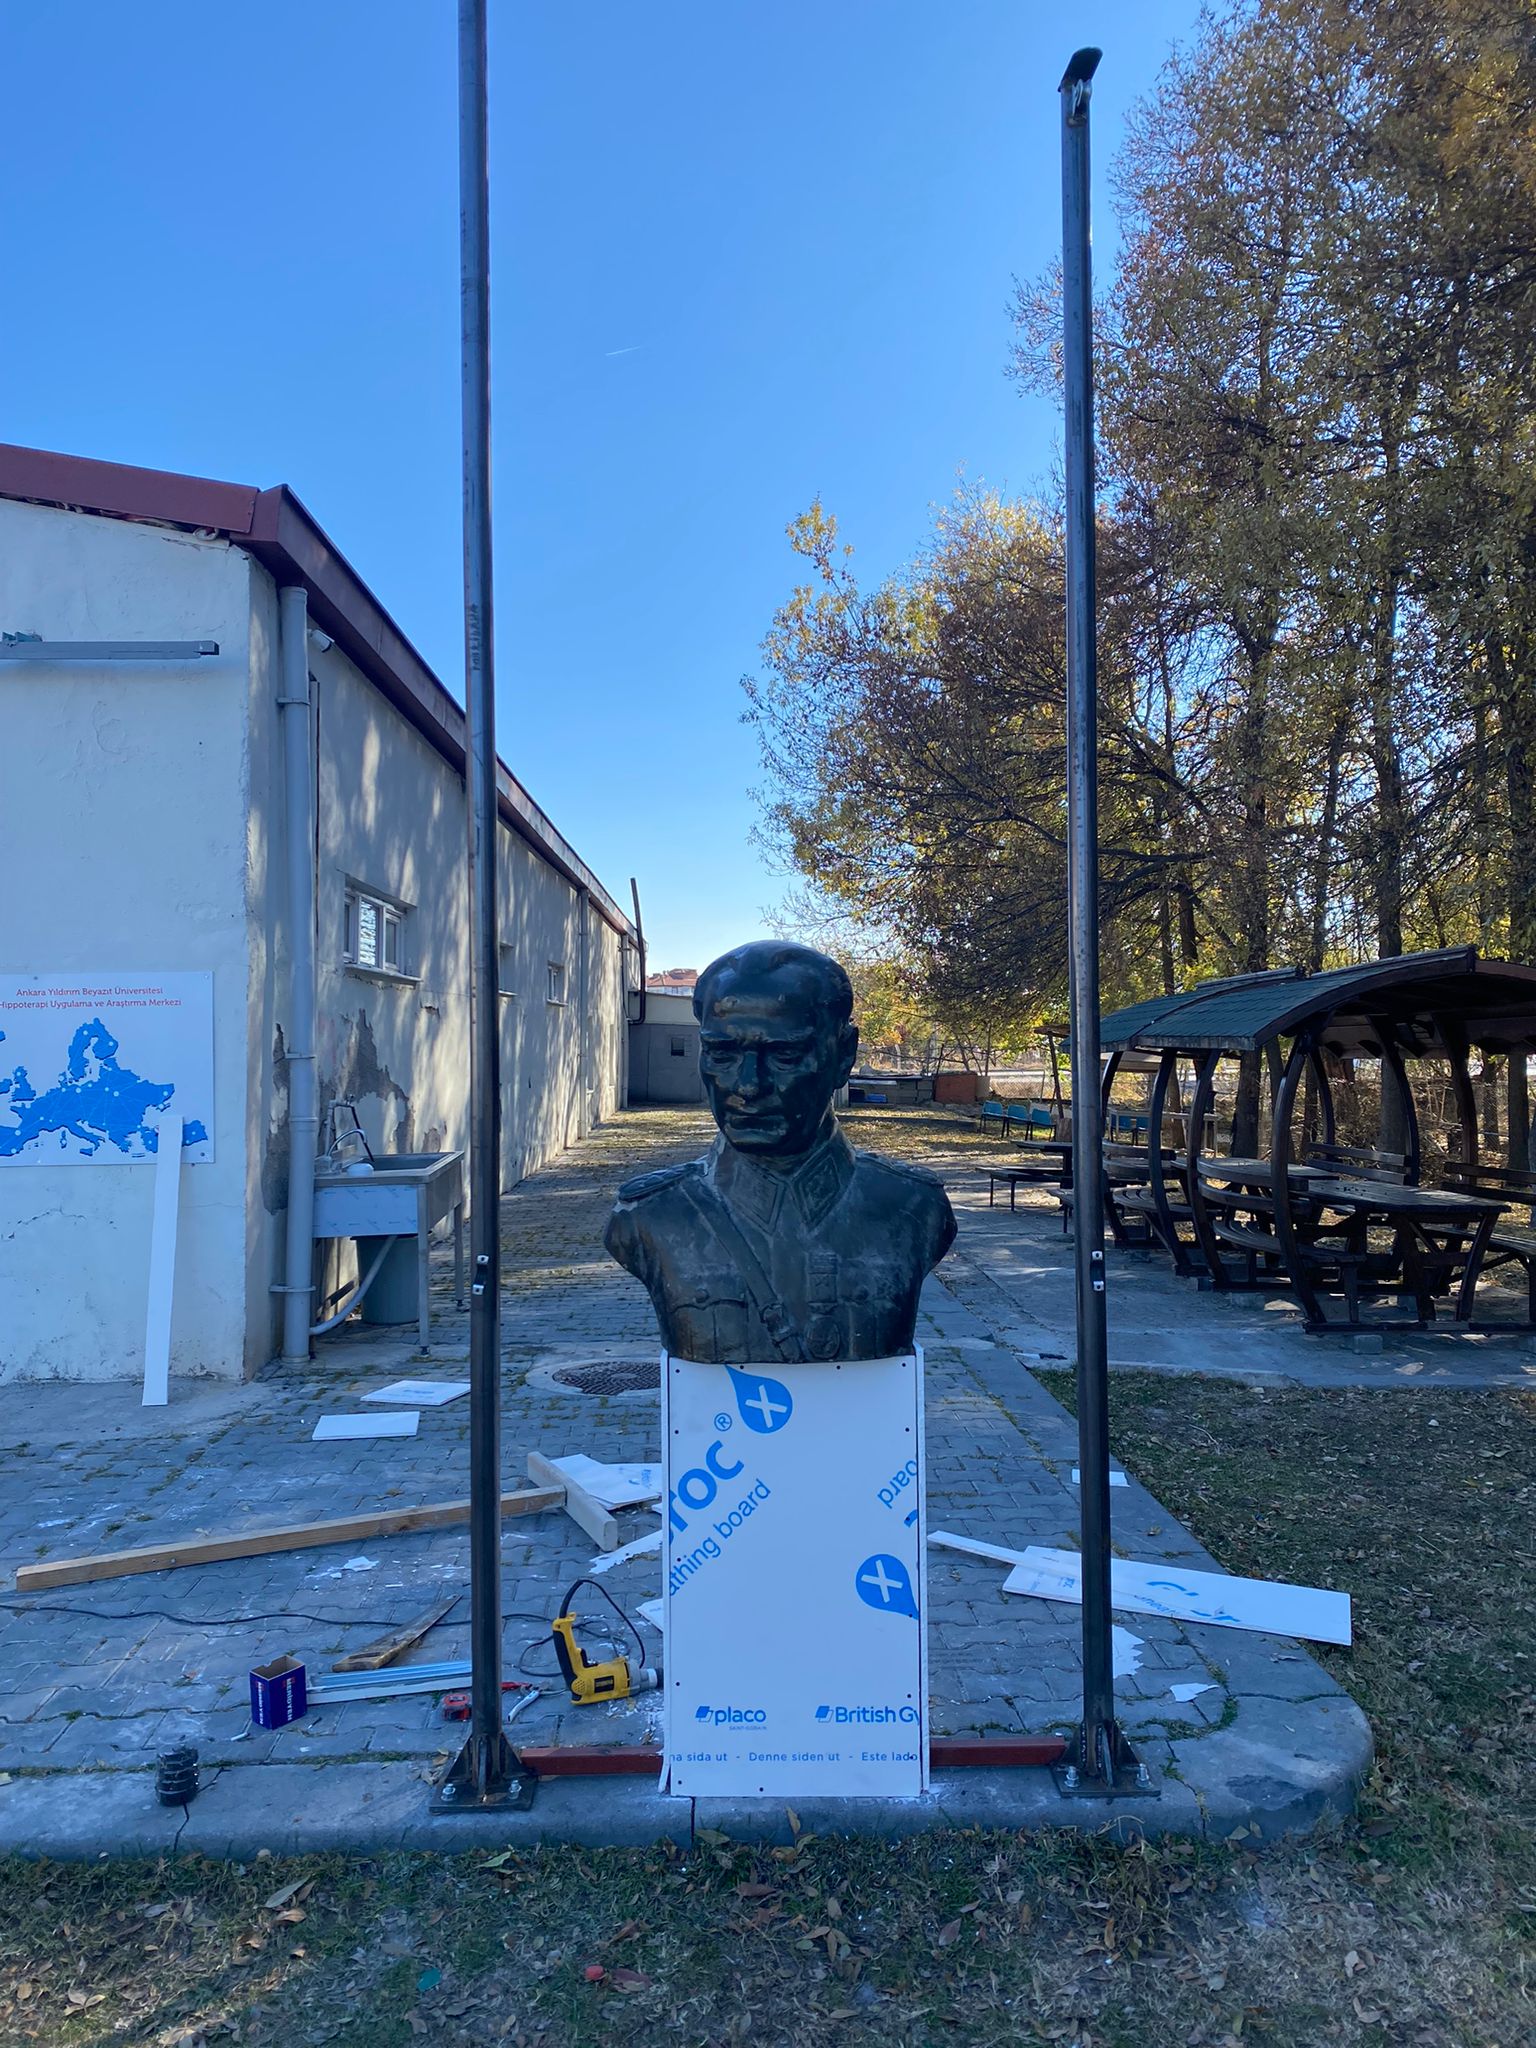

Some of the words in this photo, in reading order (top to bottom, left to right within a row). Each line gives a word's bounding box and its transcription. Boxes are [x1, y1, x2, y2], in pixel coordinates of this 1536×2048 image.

[48, 988, 80, 996] Yıldırım
[82, 987, 112, 996] Beyazıt
[114, 985, 164, 995] Üniversitesi
[50, 1000, 93, 1009] Uygulama
[106, 999, 147, 1008] Araştırma
[148, 998, 182, 1006] Merkezi
[712, 1477, 771, 1539] board
[714, 1705, 767, 1726] placo
[835, 1705, 896, 1723] British
[686, 1752, 711, 1762] sida
[715, 1752, 728, 1762] ut
[748, 1752, 788, 1762] Denne
[791, 1751, 824, 1761] siden
[827, 1752, 841, 1761] ut
[861, 1751, 888, 1761] Este
[891, 1751, 918, 1761] lado
